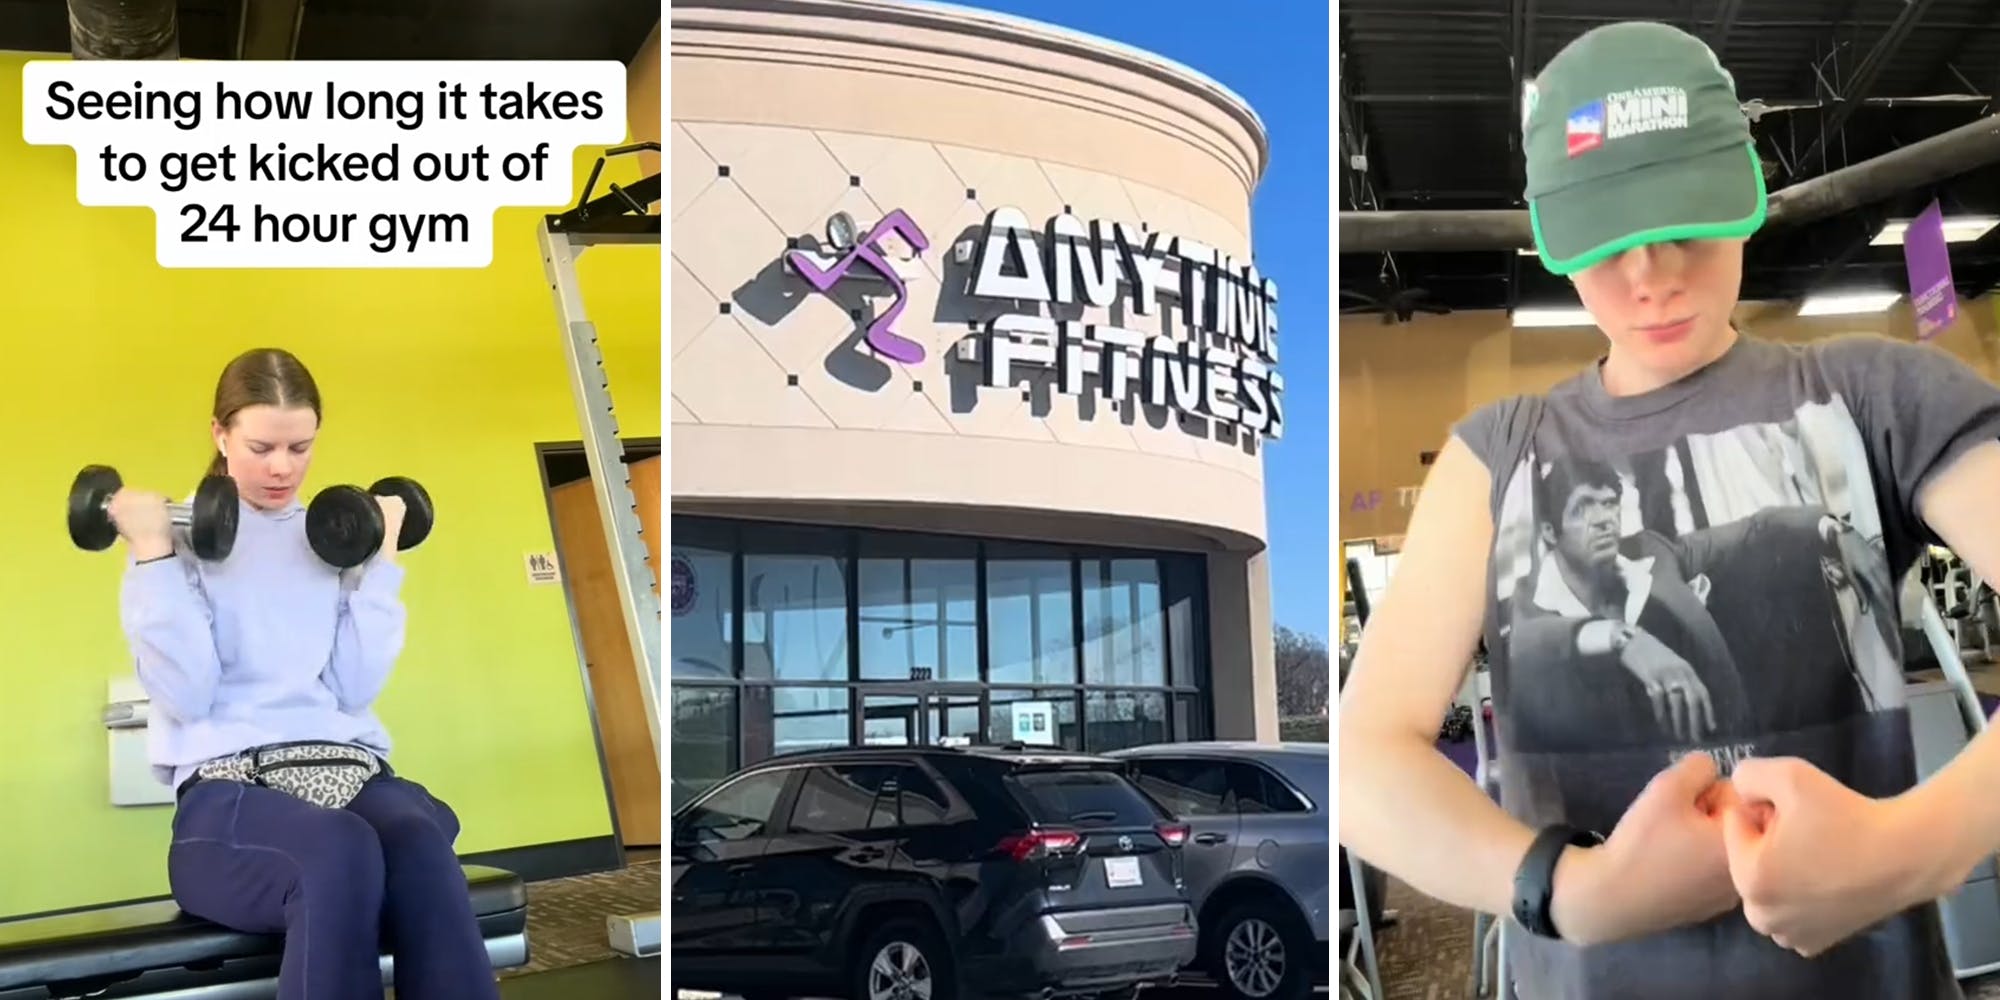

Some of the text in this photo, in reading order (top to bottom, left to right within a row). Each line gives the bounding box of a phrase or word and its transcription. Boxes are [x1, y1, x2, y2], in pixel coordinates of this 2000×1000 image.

[1607, 94, 1687, 125] MINI
[1607, 115, 1688, 139] MARATHON
[970, 203, 1278, 364] ANYTIME
[984, 313, 1284, 440] FITNESS
